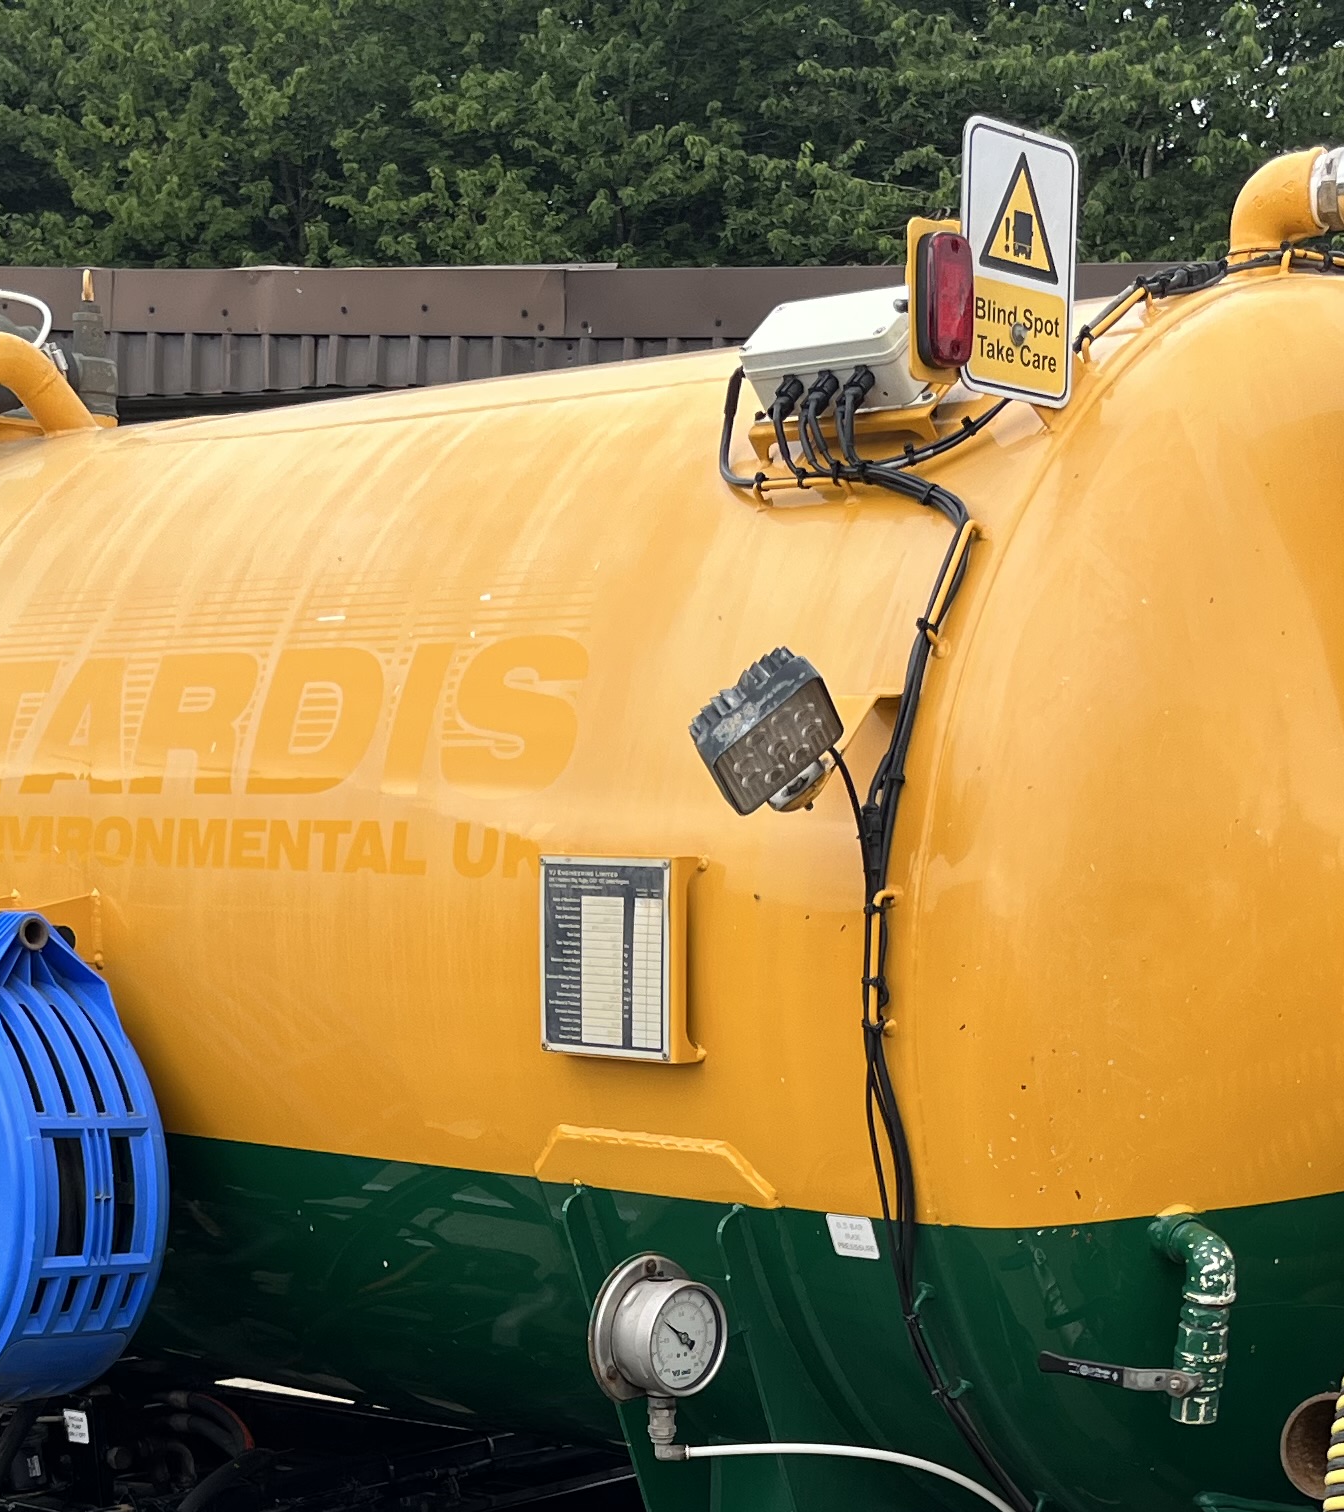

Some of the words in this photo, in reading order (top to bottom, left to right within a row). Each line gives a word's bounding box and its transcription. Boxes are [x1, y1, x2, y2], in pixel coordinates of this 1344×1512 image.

[975, 297, 1018, 327] Blind
[1023, 308, 1060, 338] Spot
[977, 334, 1015, 364] Take
[1020, 345, 1057, 373] Care
[452, 821, 540, 879] UK
